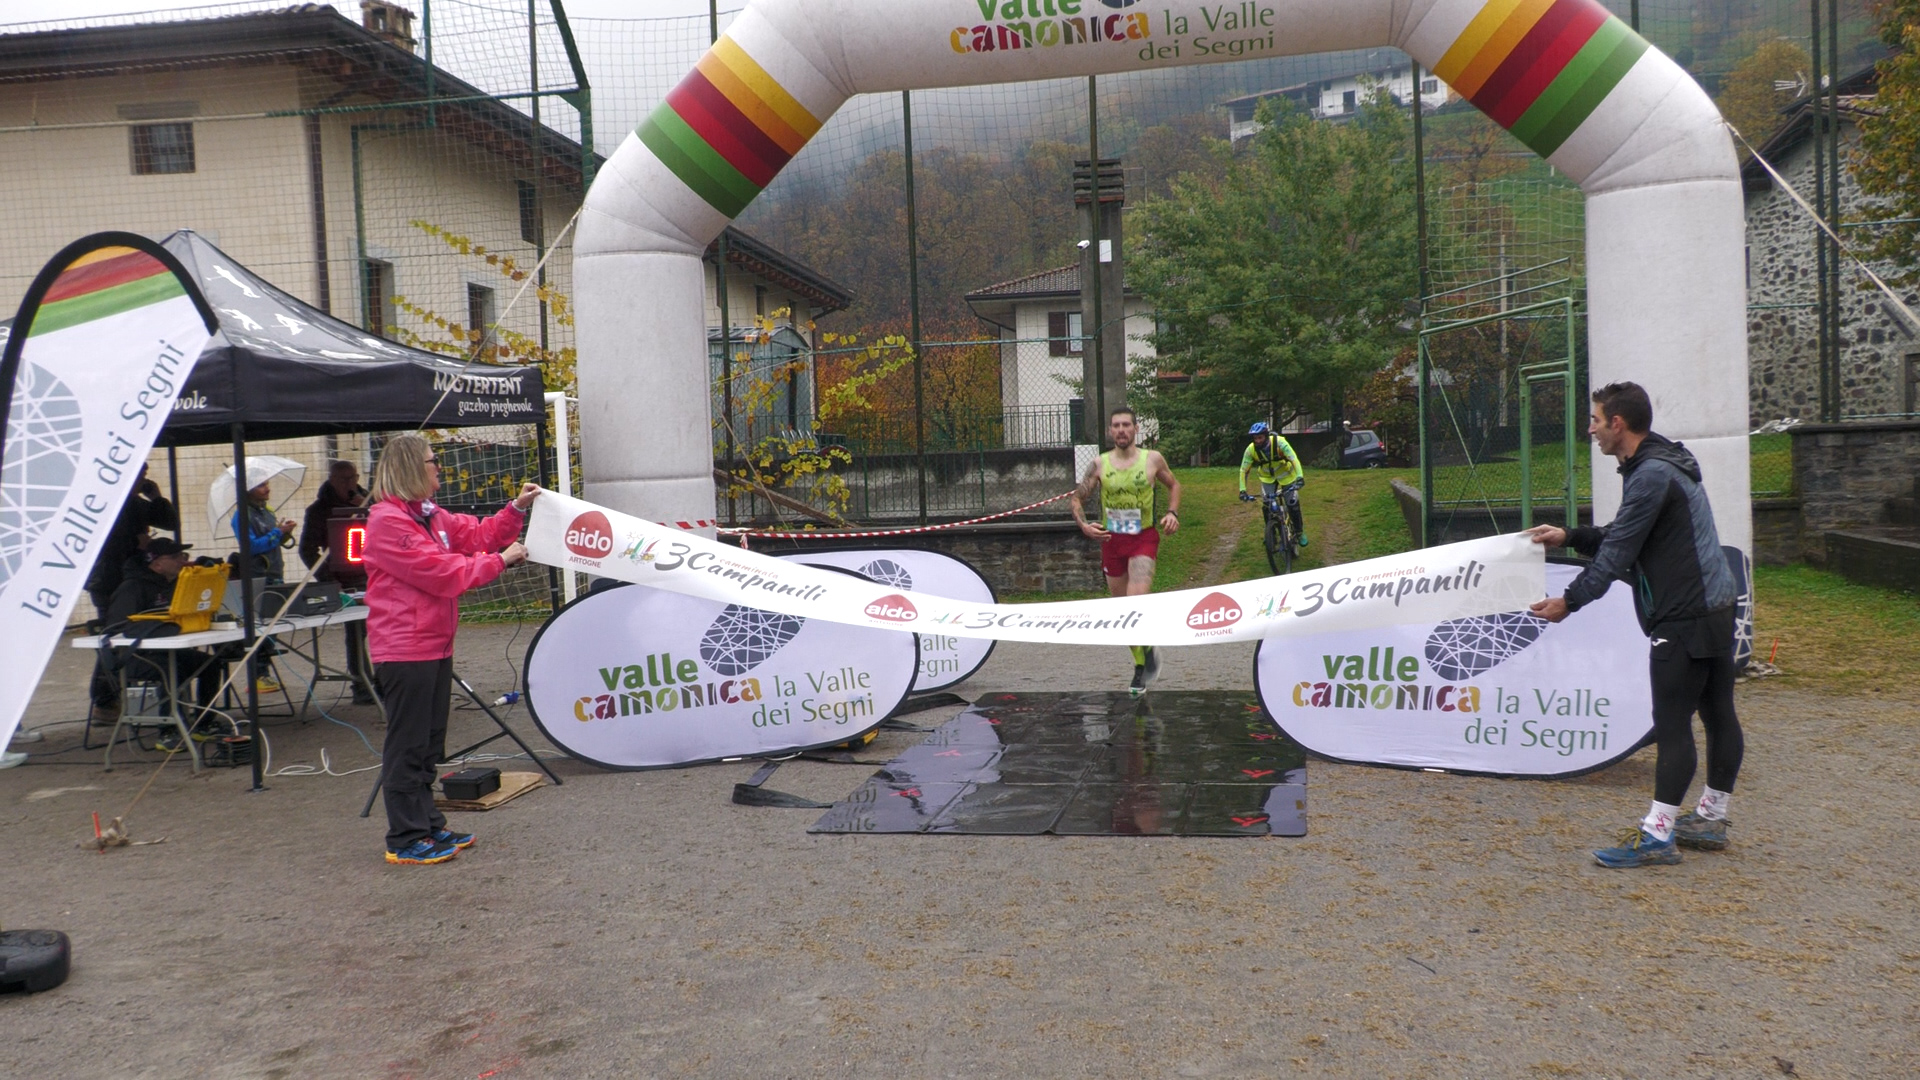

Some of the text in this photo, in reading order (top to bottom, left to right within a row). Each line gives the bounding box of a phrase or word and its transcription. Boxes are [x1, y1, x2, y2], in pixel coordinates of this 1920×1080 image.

[949, 12, 1151, 54] camonica
[1164, 1, 1275, 36] la Valle
[1138, 31, 1275, 61] dei Segni
[458, 397, 533, 417] gazebo pieghevole
[21, 339, 186, 619] la Valle dei Segni
[566, 528, 612, 553] aido
[568, 556, 601, 569] ARTOGNE
[719, 557, 779, 580] camminata
[1356, 565, 1426, 583] camminata
[865, 604, 917, 622] aido
[1188, 606, 1242, 626] aido
[919, 634, 958, 652] alle
[1194, 628, 1234, 638] ARTOGNE
[598, 652, 699, 692] valle
[918, 653, 958, 678] egni
[1323, 646, 1419, 682] valle
[773, 666, 872, 698] la Valle
[1292, 681, 1481, 713] camonica
[573, 676, 763, 722] camonica
[752, 692, 875, 728] dei Segni
[1496, 687, 1611, 718] la Valle
[1464, 718, 1608, 756] dei Segni
